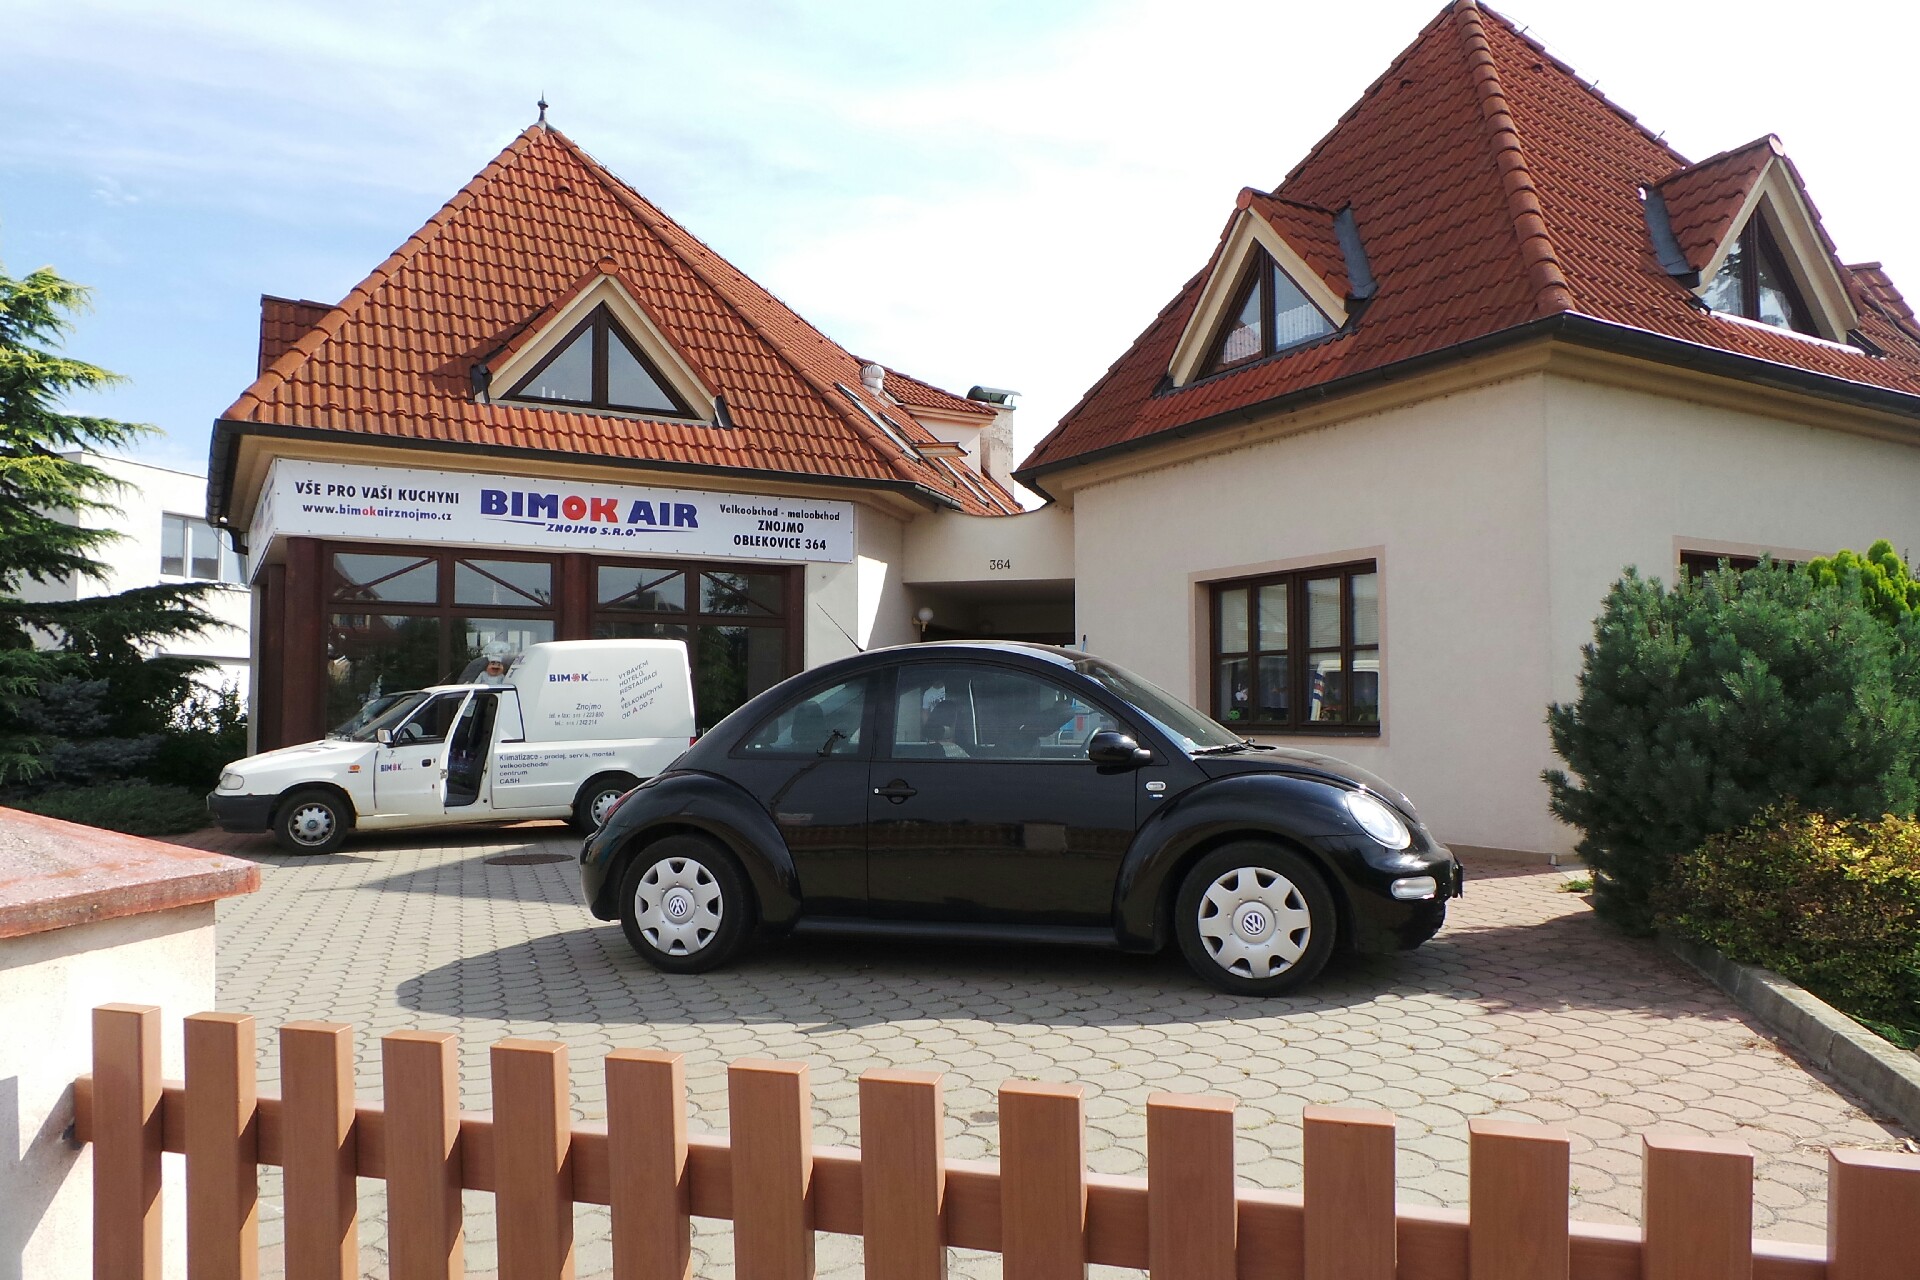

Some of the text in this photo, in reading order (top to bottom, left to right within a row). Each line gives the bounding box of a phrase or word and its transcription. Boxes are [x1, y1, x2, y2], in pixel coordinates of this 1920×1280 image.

[295, 480, 459, 504] VŠE PRO VAŠI KUCHYNI
[302, 503, 452, 521] www.bimokairznojmo.cz
[480, 489, 699, 528] BIMOK AIR
[719, 504, 778, 517] Velkoobchod
[787, 510, 840, 521] maloobchod
[546, 523, 637, 537] ZNOJMO S.R.O.
[757, 520, 805, 533] ZNOJMO
[733, 534, 827, 550] OBLEKOVICE 364
[989, 559, 1010, 570] 364
[576, 703, 601, 711] Znojmo
[499, 753, 539, 761] Klimatizace
